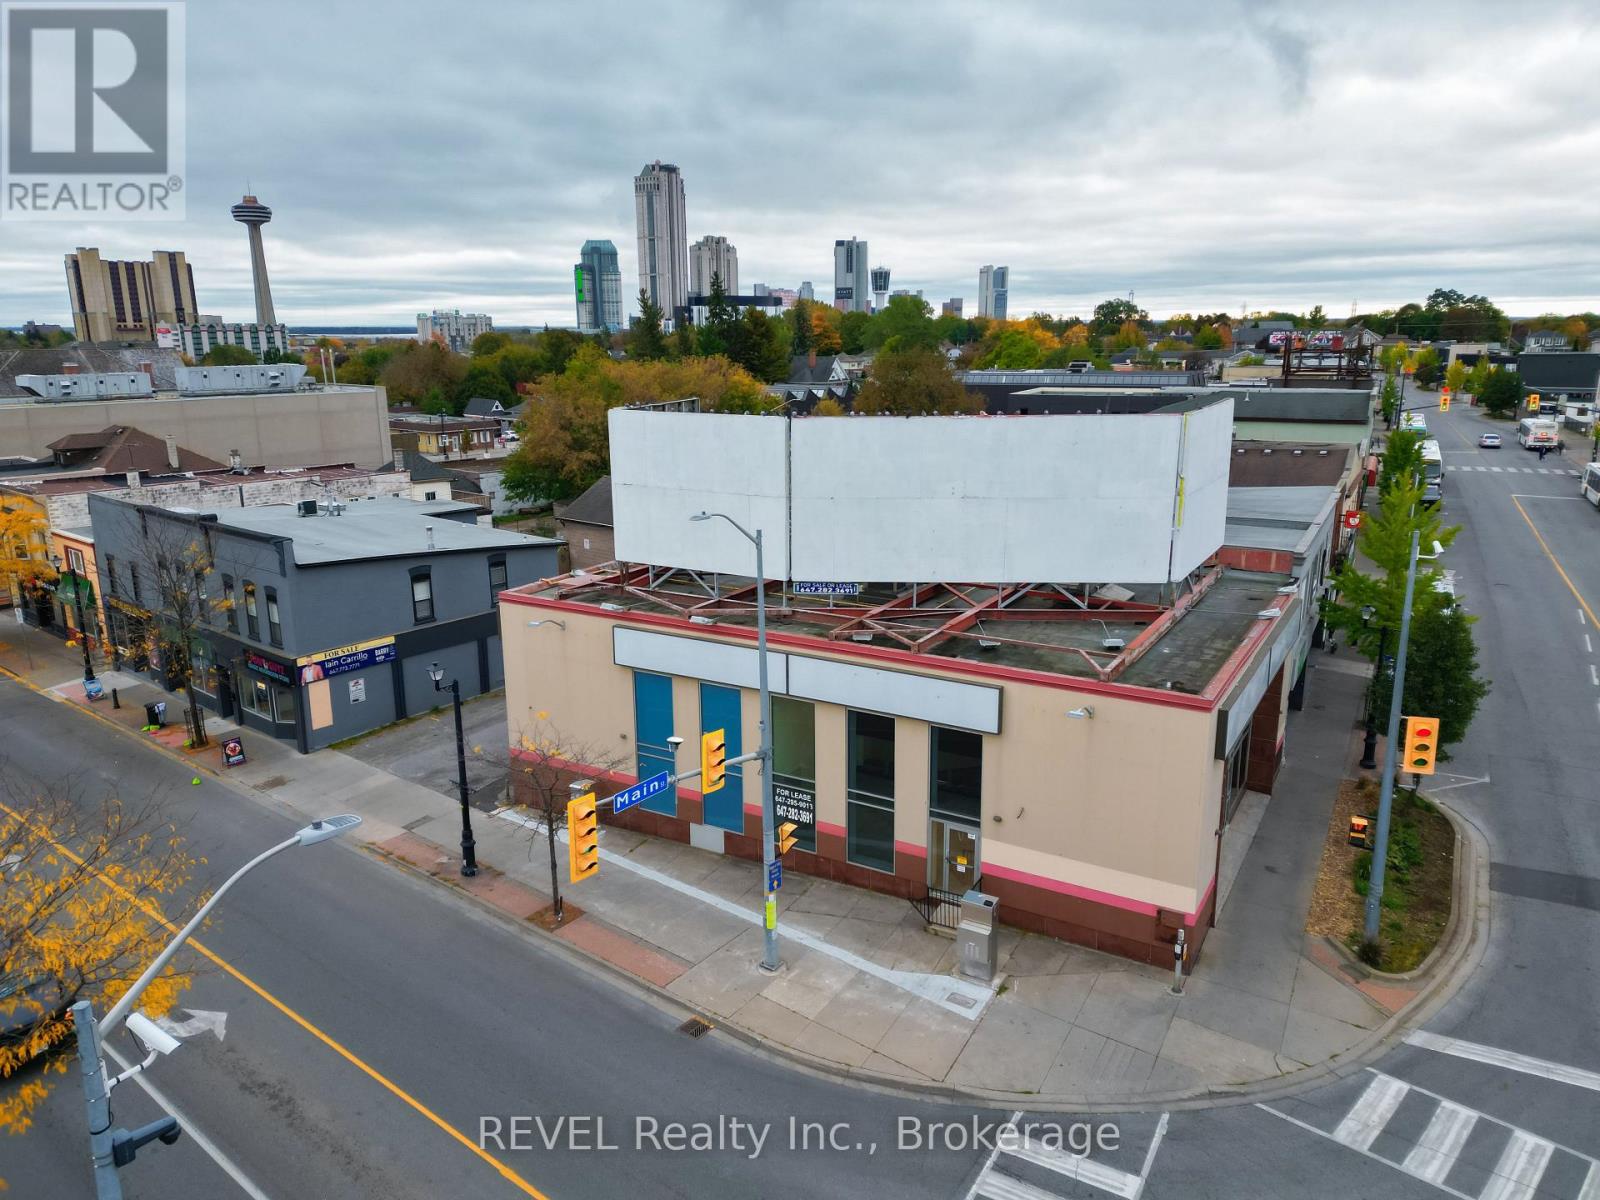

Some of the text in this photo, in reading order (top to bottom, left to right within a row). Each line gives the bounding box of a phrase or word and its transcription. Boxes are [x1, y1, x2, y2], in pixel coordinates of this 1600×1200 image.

[324, 645, 360, 659] FOR SALE
[324, 659, 339, 669] Iain
[340, 652, 368, 665] Carrillo
[616, 781, 659, 809] Main
[776, 787, 812, 802] FOR LEASE
